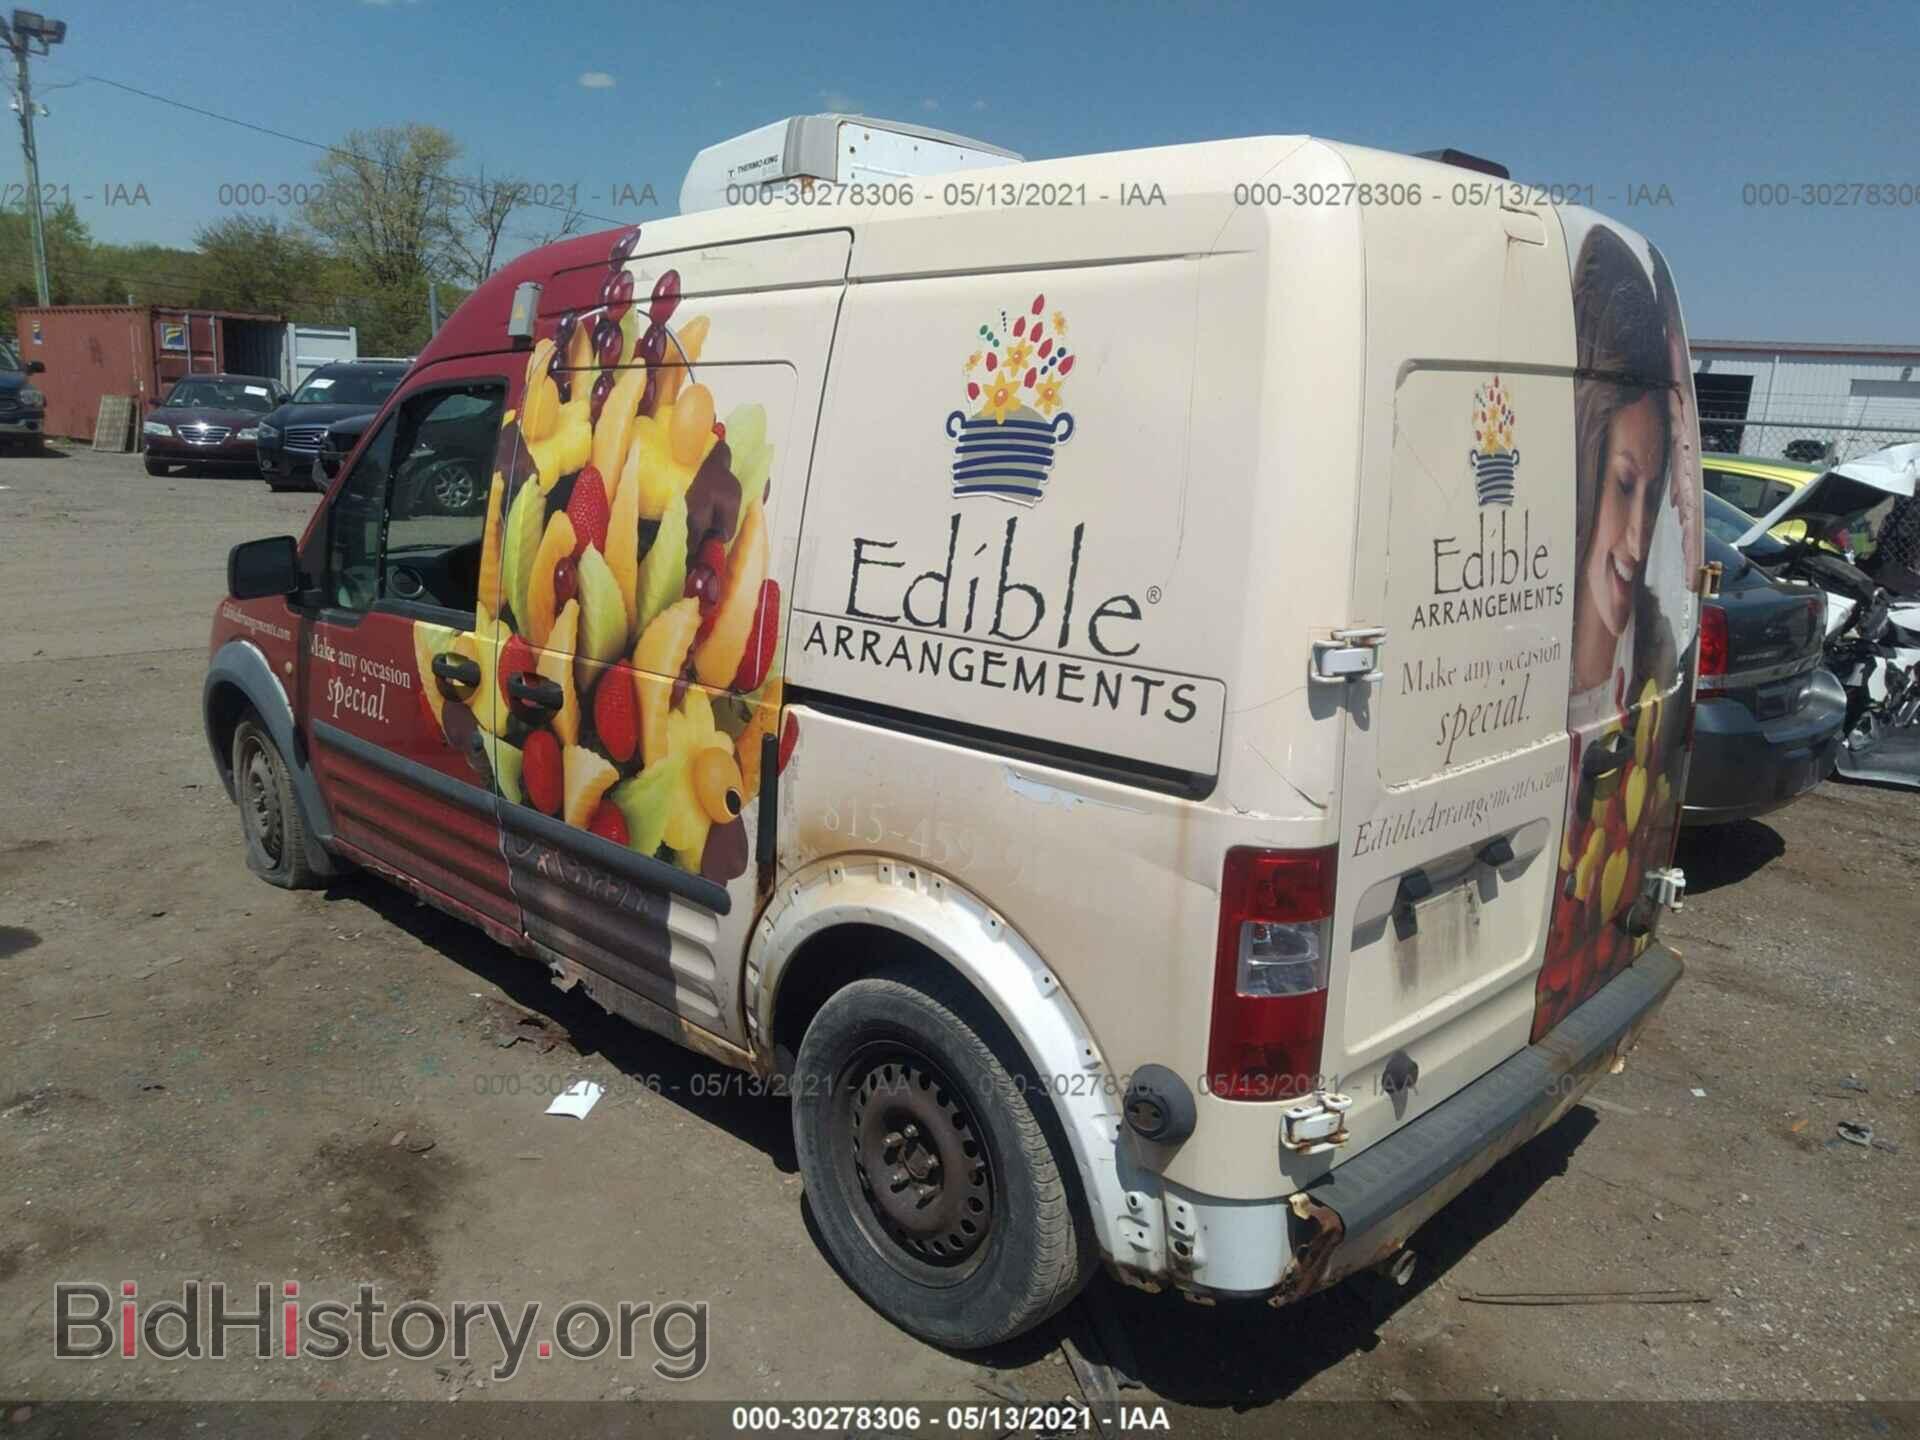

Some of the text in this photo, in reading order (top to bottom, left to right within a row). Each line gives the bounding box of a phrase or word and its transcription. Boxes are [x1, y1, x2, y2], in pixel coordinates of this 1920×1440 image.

[1433, 509, 1549, 595] Edible
[1411, 583, 1563, 630] ARRANGEMENTS
[311, 634, 411, 689] Make any occasion
[803, 621, 1198, 723] ARRANGEMENTS
[1401, 641, 1561, 695] Make any occasion
[327, 675, 390, 724] special.
[1435, 672, 1530, 765] special.
[1352, 764, 1566, 858] EdibleArrangements.com
